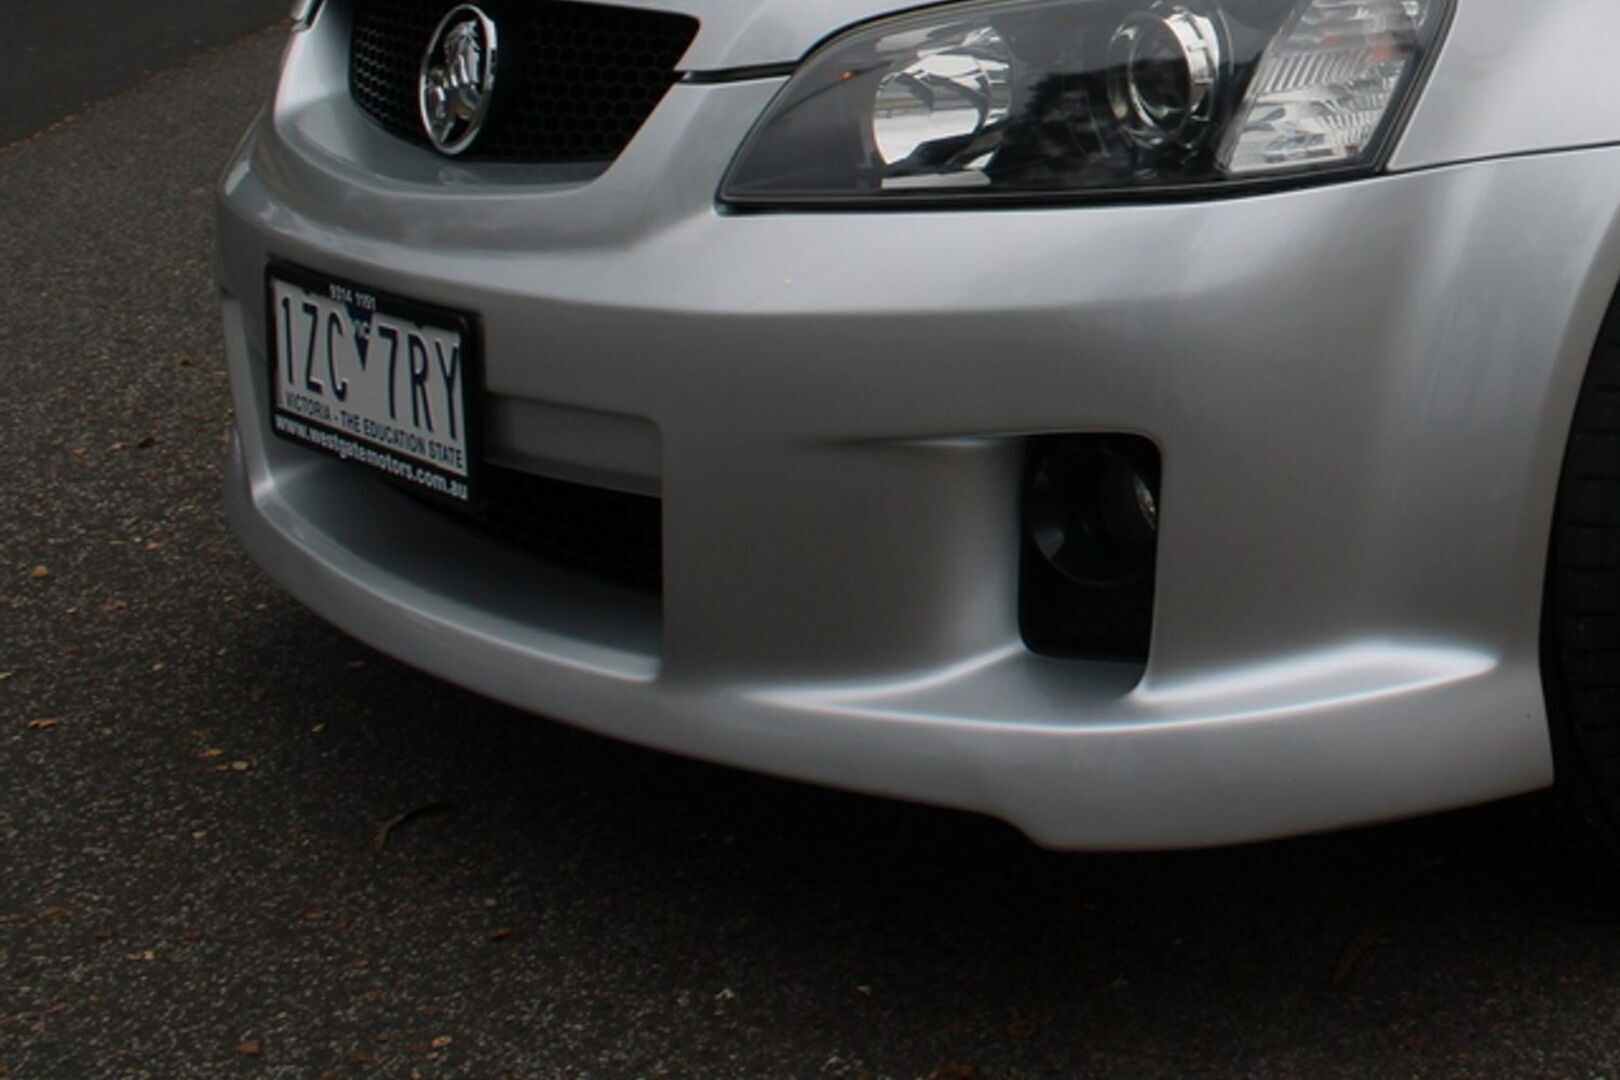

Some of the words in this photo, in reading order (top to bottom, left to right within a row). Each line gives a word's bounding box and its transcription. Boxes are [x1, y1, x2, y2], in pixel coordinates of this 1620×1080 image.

[281, 295, 347, 402] 1ZC
[377, 324, 462, 440] 7RY
[274, 414, 469, 501] www.westgatemotors.com.au
[285, 390, 332, 420] VICTORIA
[340, 409, 361, 433] THE
[363, 418, 427, 454] EDUCATION
[428, 439, 464, 469] STATE
